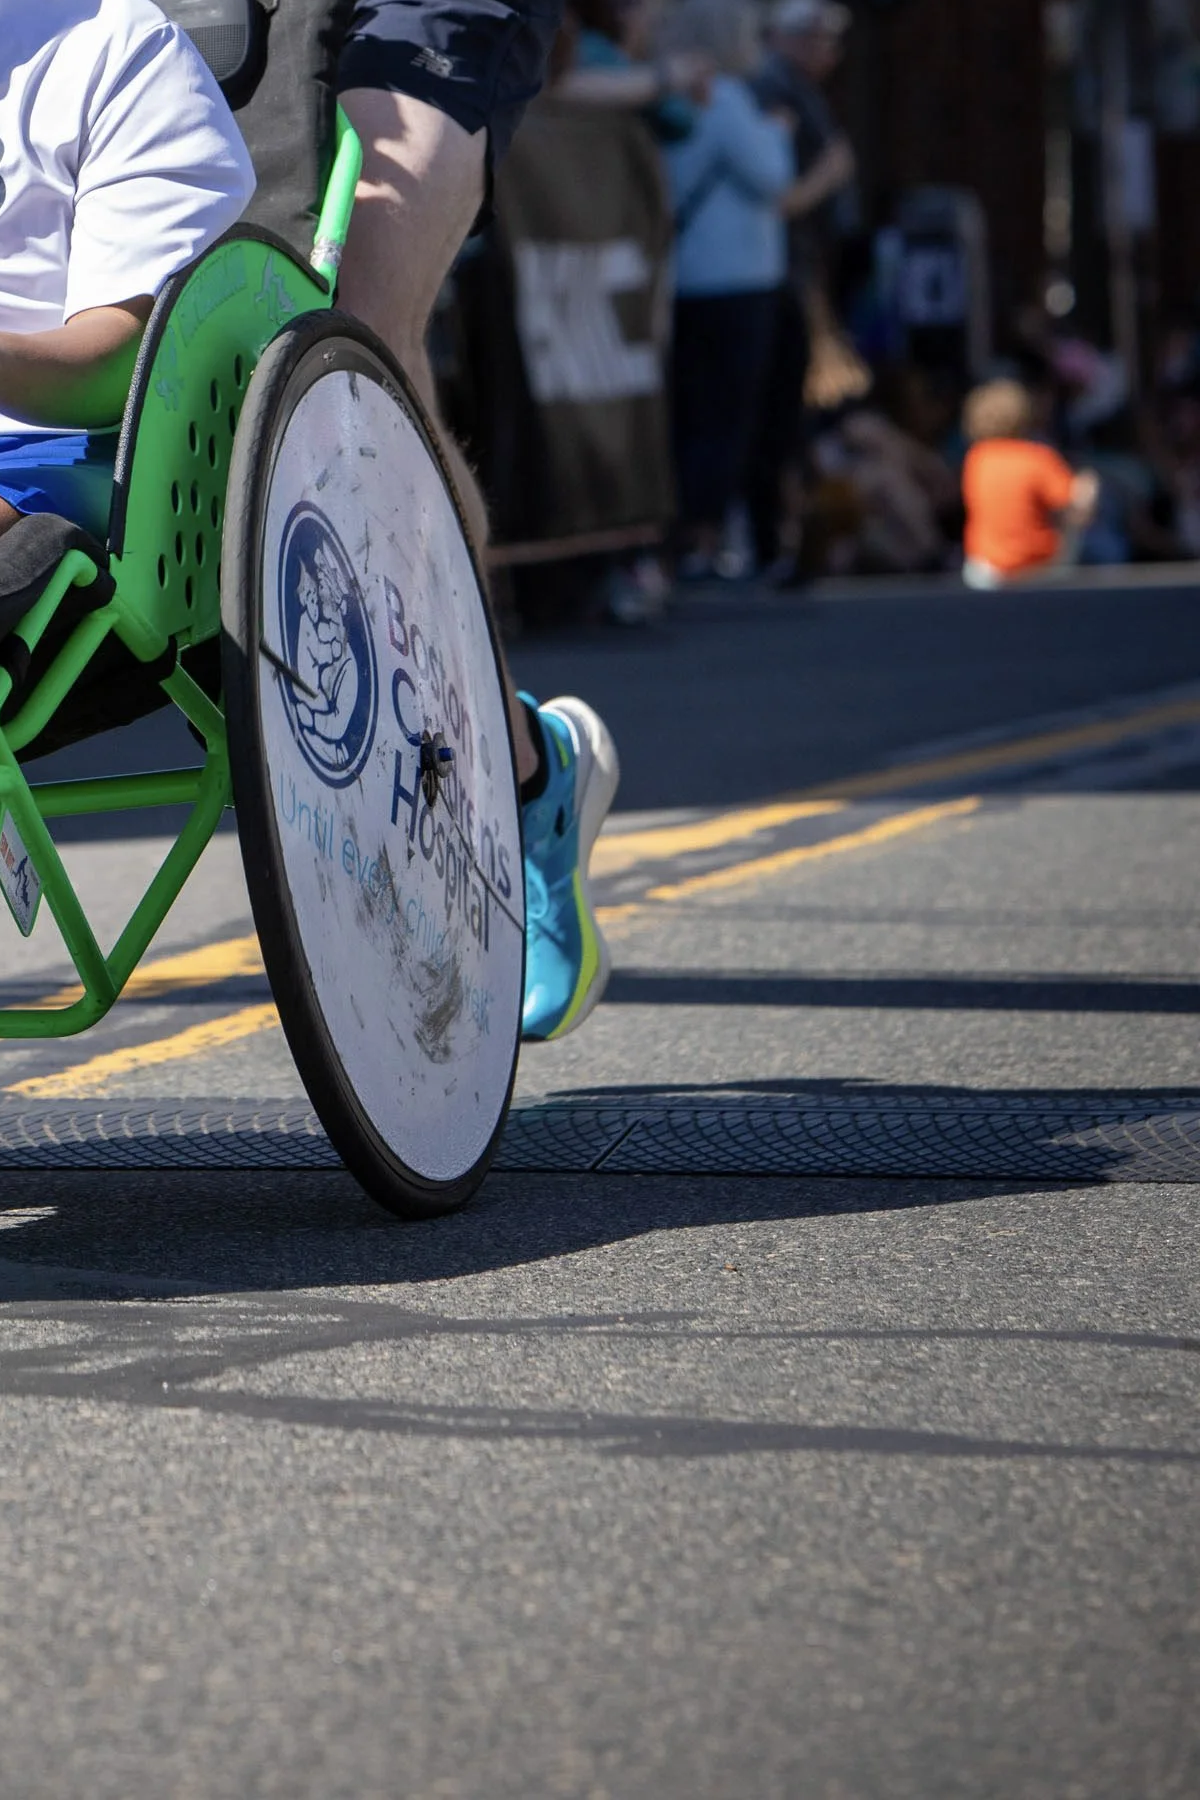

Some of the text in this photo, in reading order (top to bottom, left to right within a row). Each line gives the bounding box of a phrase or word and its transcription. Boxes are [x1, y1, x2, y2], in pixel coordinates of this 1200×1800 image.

[384, 574, 473, 768] Boston
[279, 771, 334, 861] Until
[391, 749, 490, 953] Hospital
[392, 668, 511, 899] Cdren's
